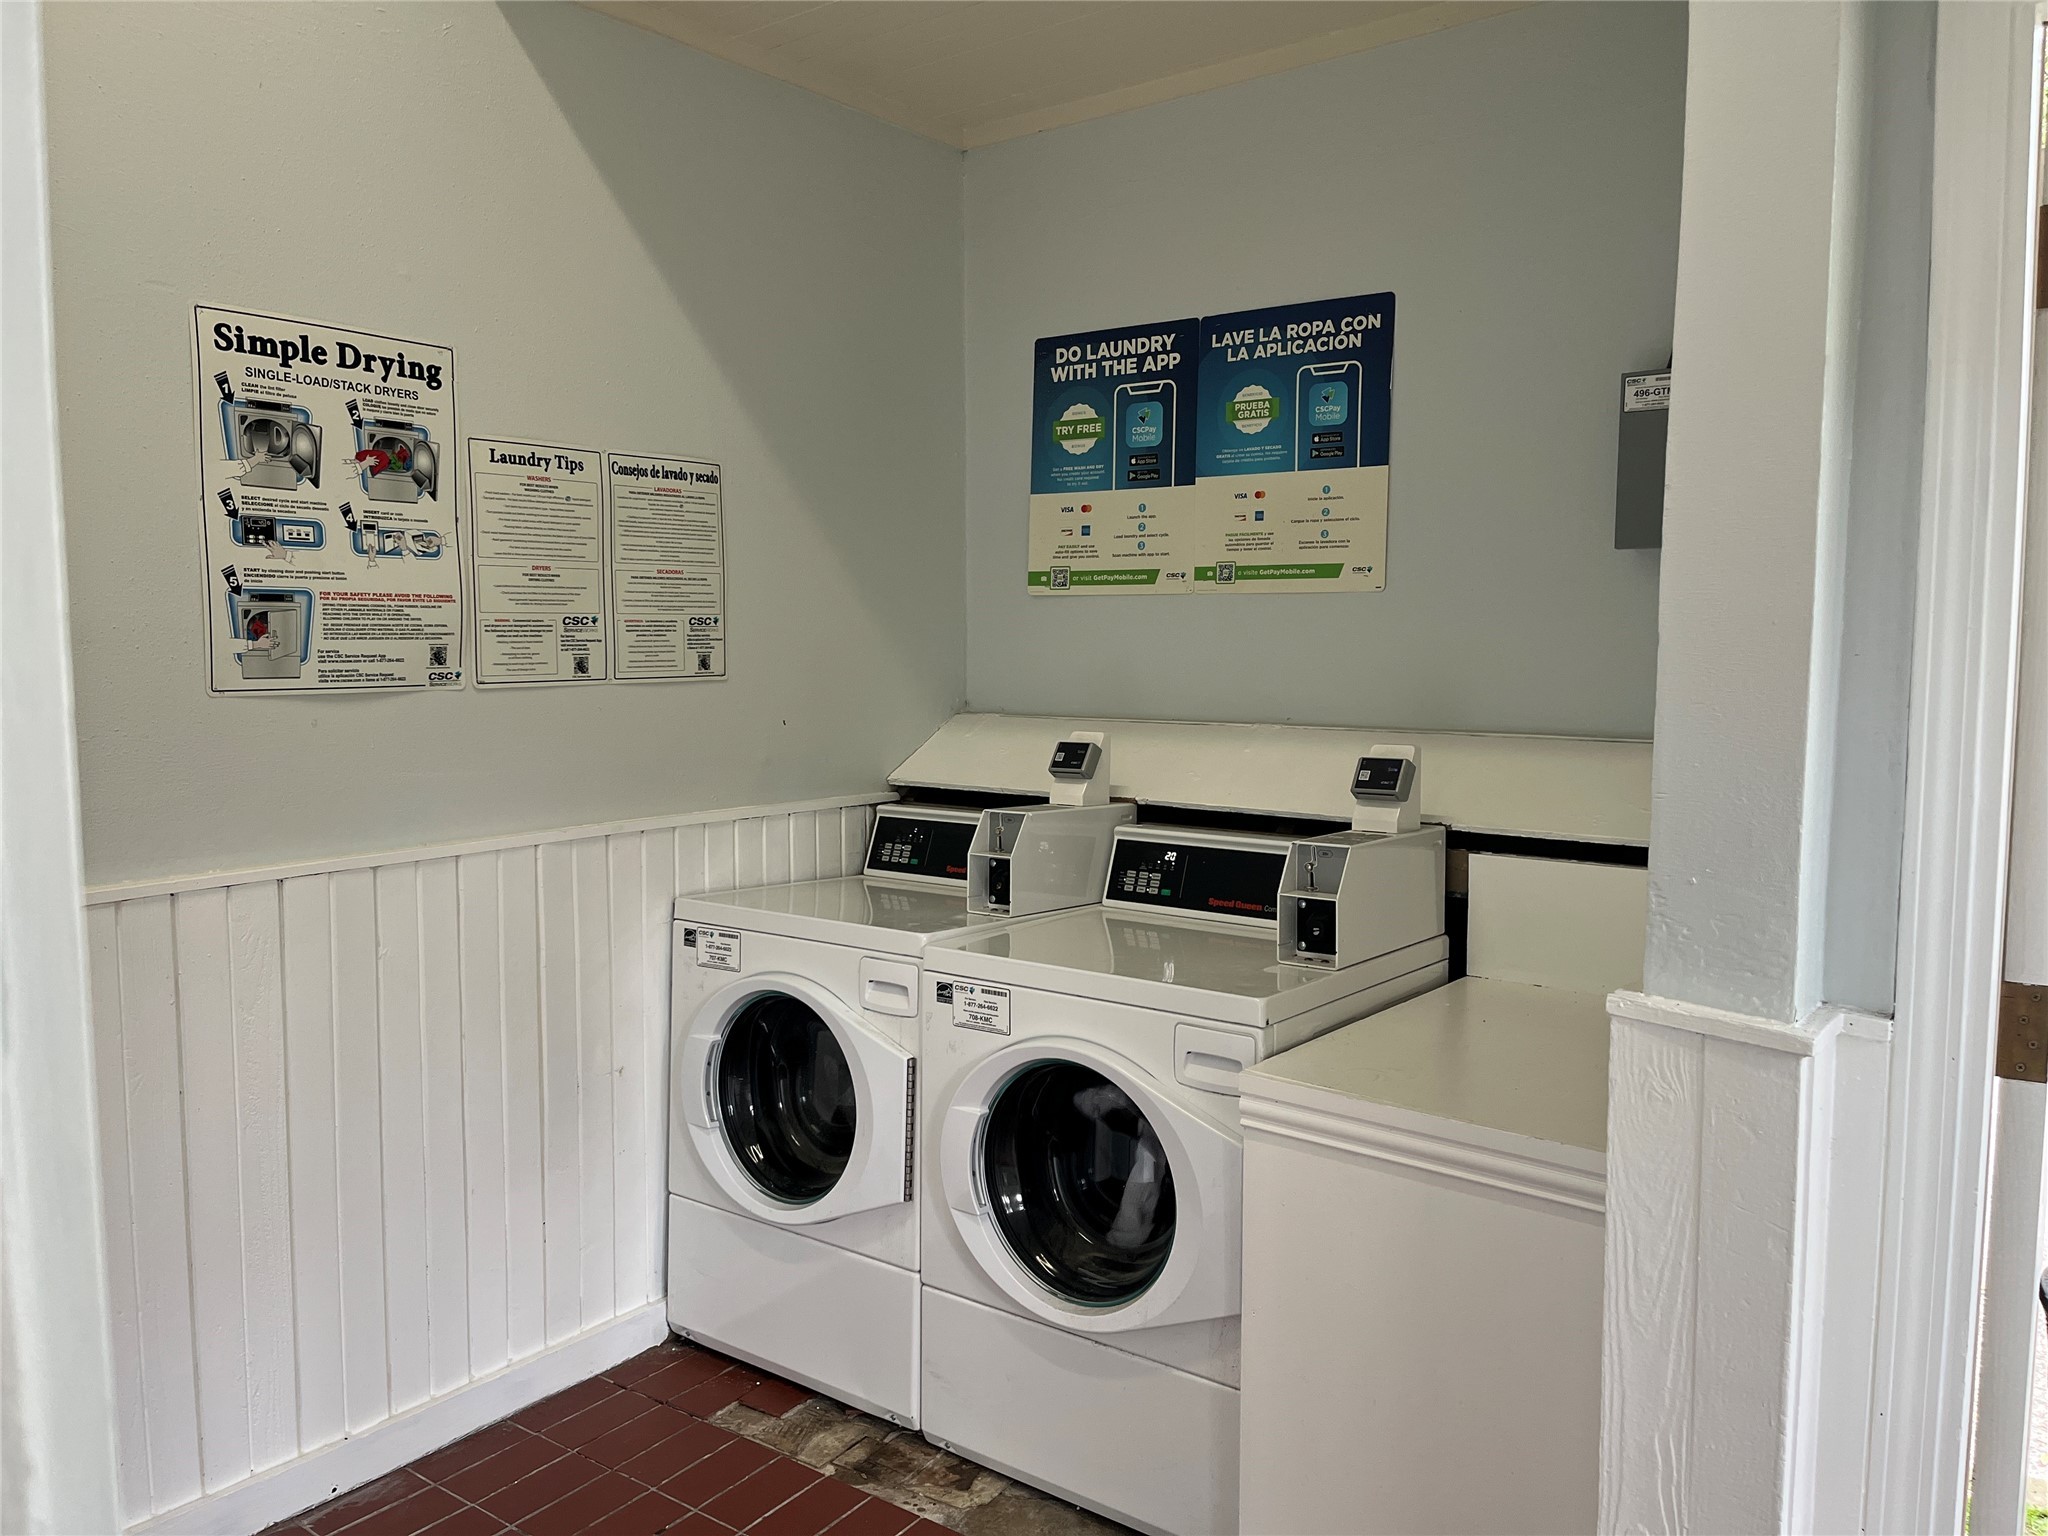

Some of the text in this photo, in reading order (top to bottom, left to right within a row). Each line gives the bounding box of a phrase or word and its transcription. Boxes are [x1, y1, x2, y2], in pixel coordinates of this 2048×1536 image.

[1212, 314, 1381, 348] LAVE LA ROPA CON
[1056, 334, 1175, 364] DO LAUNDRY
[1227, 331, 1361, 362] LA APLICACIÓN
[214, 323, 442, 390] Simple Drying
[1051, 353, 1180, 382] WITH THE APP
[245, 367, 419, 400] SINGLE-LOAD/STACK DRYERS
[1235, 401, 1270, 411] PRUEBA
[352, 410, 360, 420] 2
[1238, 409, 1269, 419] GRATIS
[1056, 423, 1101, 435] TRY FREE
[1132, 434, 1156, 442] Mobile
[489, 449, 584, 472] Laundry Tips
[611, 461, 719, 485] Consejos de lavado y secado
[225, 500, 233, 510] 3
[346, 514, 353, 523] 4
[1260, 567, 1315, 576] GetPayMobile.com
[229, 577, 238, 586] 5
[1093, 572, 1148, 582] GetPayMobile.com
[563, 616, 589, 625] CSC
[689, 617, 712, 626] CSC
[429, 672, 453, 680] CSC
[1164, 852, 1177, 861] 20
[1208, 898, 1234, 908] Speed
[1236, 901, 1262, 911] Queen
[969, 1014, 992, 1023] 708-KMC
